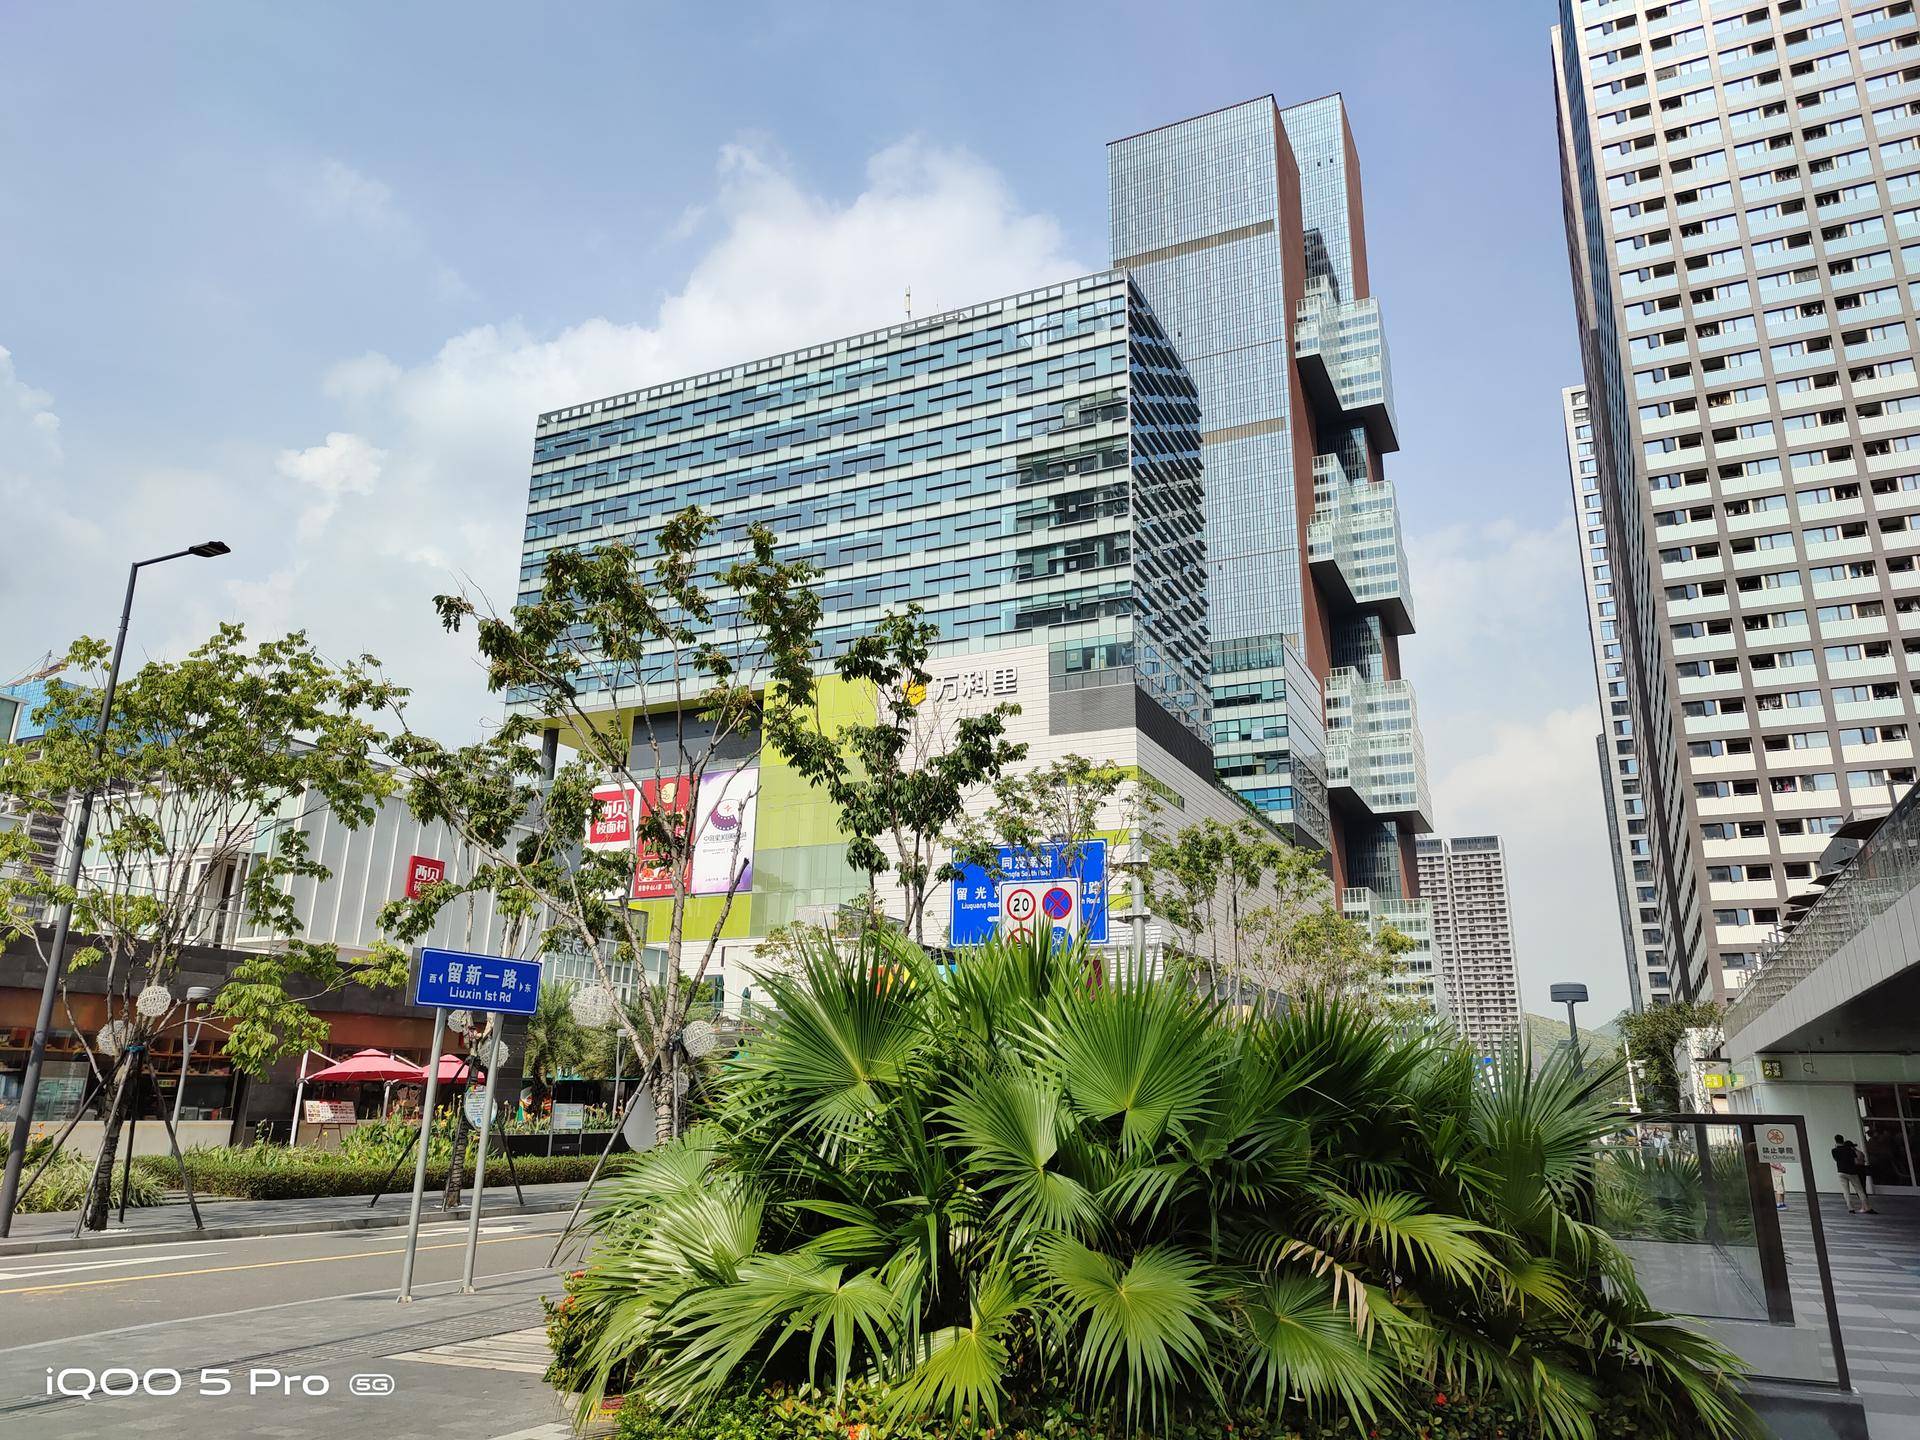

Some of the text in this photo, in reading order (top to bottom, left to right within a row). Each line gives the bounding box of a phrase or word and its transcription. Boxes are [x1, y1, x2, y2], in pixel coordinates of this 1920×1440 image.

[936, 665, 1017, 702] 万科里
[415, 864, 440, 883] 西贝
[961, 902, 986, 911] Liuguang
[1013, 898, 1030, 912] 20
[429, 973, 437, 984] 西
[447, 962, 517, 990] 留新一路
[449, 986, 512, 1003] Liuxin 1st Rd
